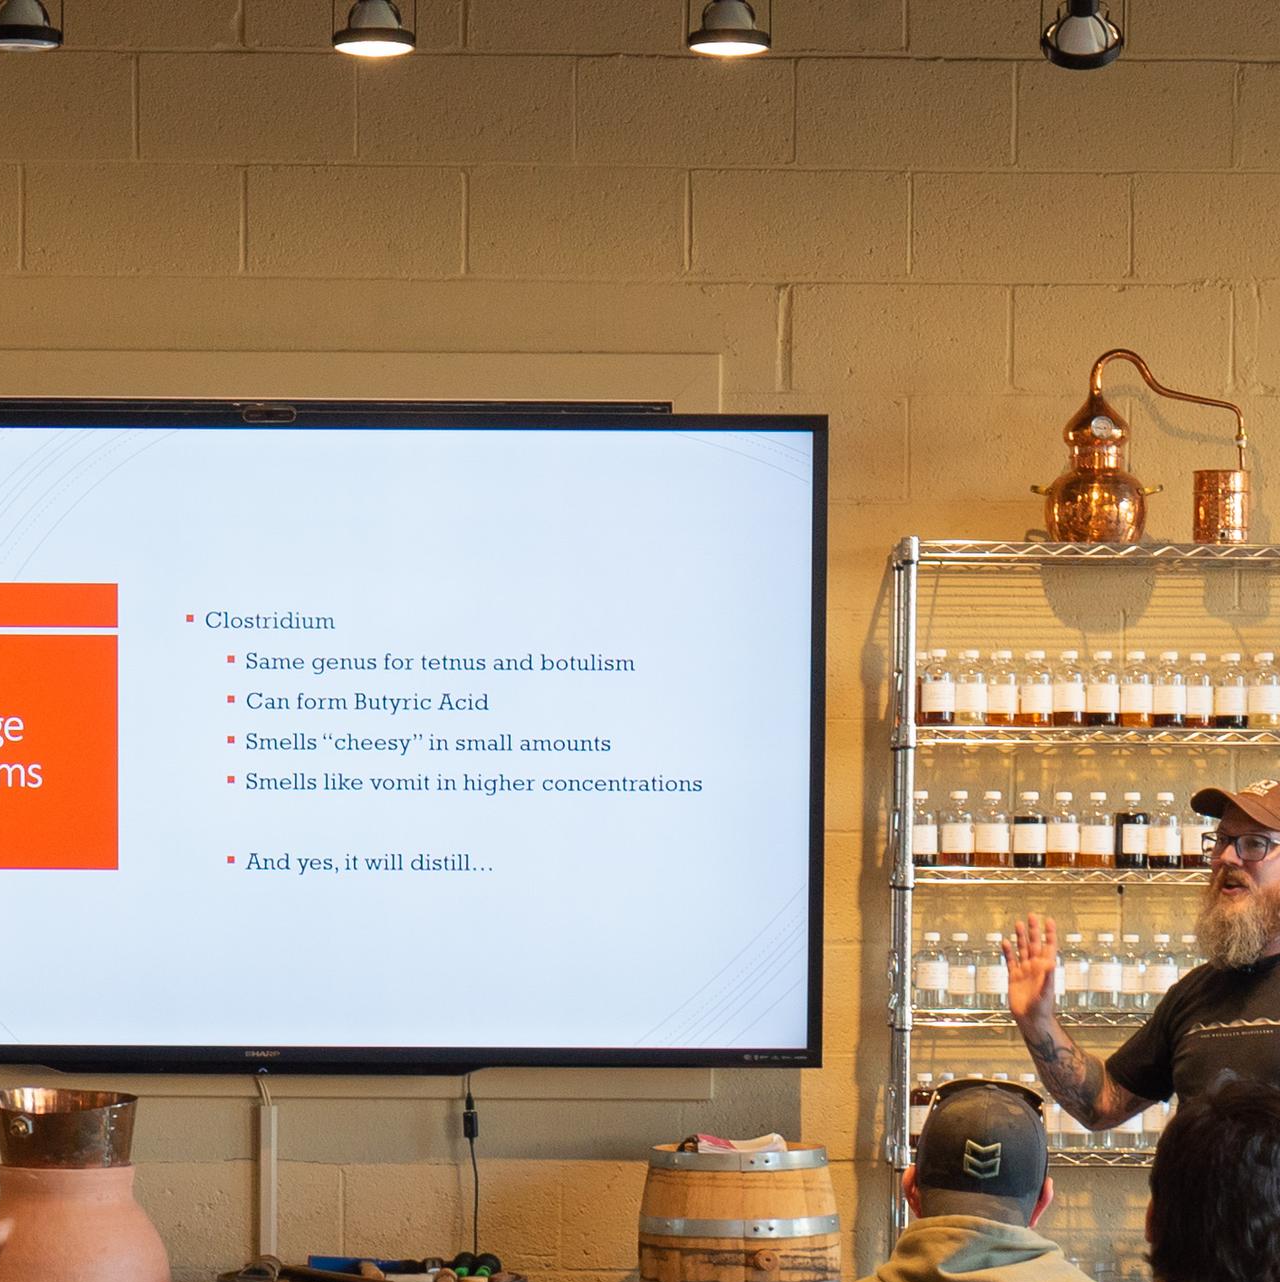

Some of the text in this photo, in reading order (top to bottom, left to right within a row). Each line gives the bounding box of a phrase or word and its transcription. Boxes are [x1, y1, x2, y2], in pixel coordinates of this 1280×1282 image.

[204, 610, 337, 631] Clostridium
[245, 651, 637, 676] Same genus for tetnus and botulism
[245, 692, 490, 717] Can form Butyric Acid
[245, 732, 319, 752] Smells
[427, 733, 450, 752] in
[454, 733, 514, 753] small
[518, 736, 612, 753] amounts
[245, 771, 704, 798] Smells like vomit in higher concentrations
[245, 852, 292, 872] And
[295, 857, 340, 877] yes,
[343, 853, 359, 872] it
[363, 853, 405, 872] will
